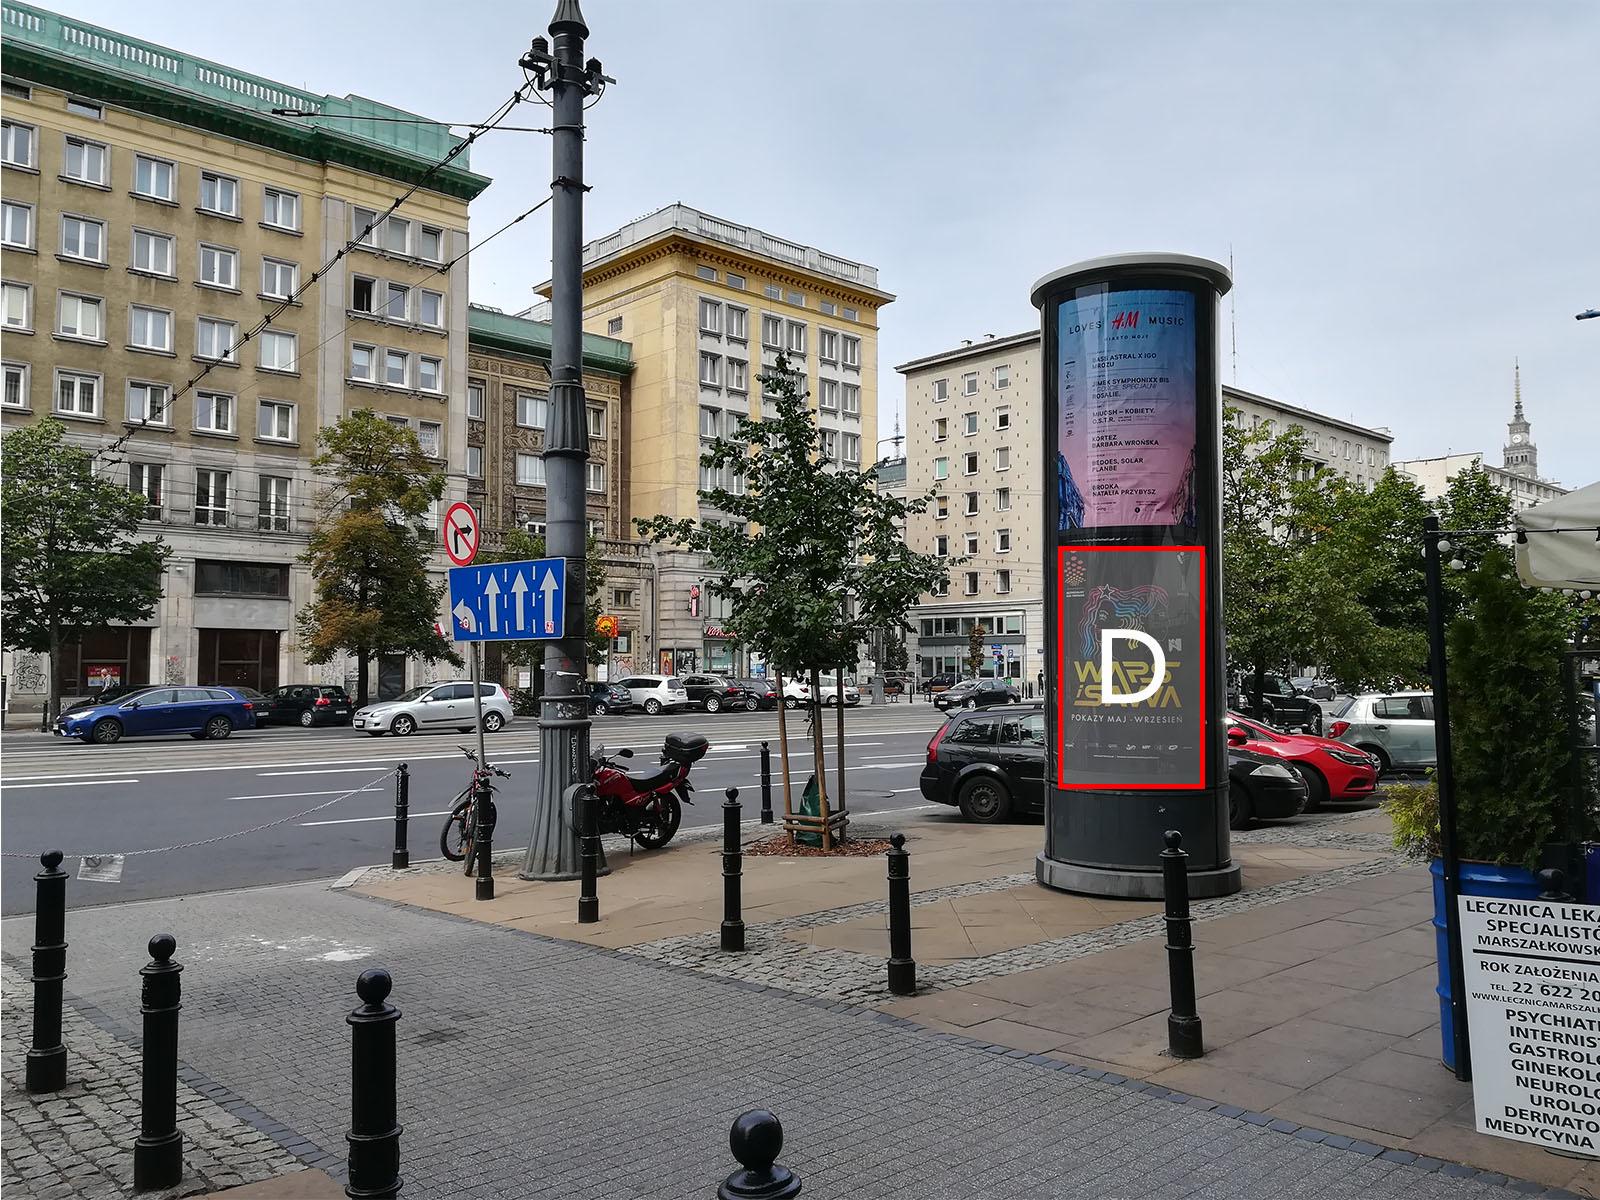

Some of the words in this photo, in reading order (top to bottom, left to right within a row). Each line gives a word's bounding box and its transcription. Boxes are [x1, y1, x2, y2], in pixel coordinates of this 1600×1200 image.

[1069, 321, 1102, 335] LOVES
[1111, 311, 1140, 330] H&M
[1149, 315, 1185, 326] MUSIC
[1109, 353, 1137, 361] ASTRAL
[1121, 457, 1144, 465] SOLAR
[1092, 489, 1119, 497] NATALIA
[1121, 488, 1157, 496] PRZYBYSZ
[1071, 713, 1104, 723] POKAZY
[1107, 716, 1127, 724] MAJ
[1134, 715, 1183, 724] WRZESIEŃ
[1466, 900, 1555, 919] LECZNICA
[1561, 907, 1600, 923] LEK
[1480, 961, 1511, 974] ROK
[1514, 964, 1600, 984] ZAŁOŻENIA
[1490, 983, 1510, 992] TEL.
[1512, 981, 1533, 995] 22
[1540, 984, 1573, 999] 622
[1472, 992, 1600, 1014] WWW.LECZNICAMARSZAL
[1506, 1009, 1600, 1033] PSYCHIAT
[1510, 1026, 1600, 1048] INTERNIS
[1508, 1042, 1600, 1066] GASTROL
[1530, 1094, 1600, 1117] UROLO
[1505, 1105, 1600, 1134] DERMATO
[1485, 1118, 1595, 1149] MEDYCYNA
